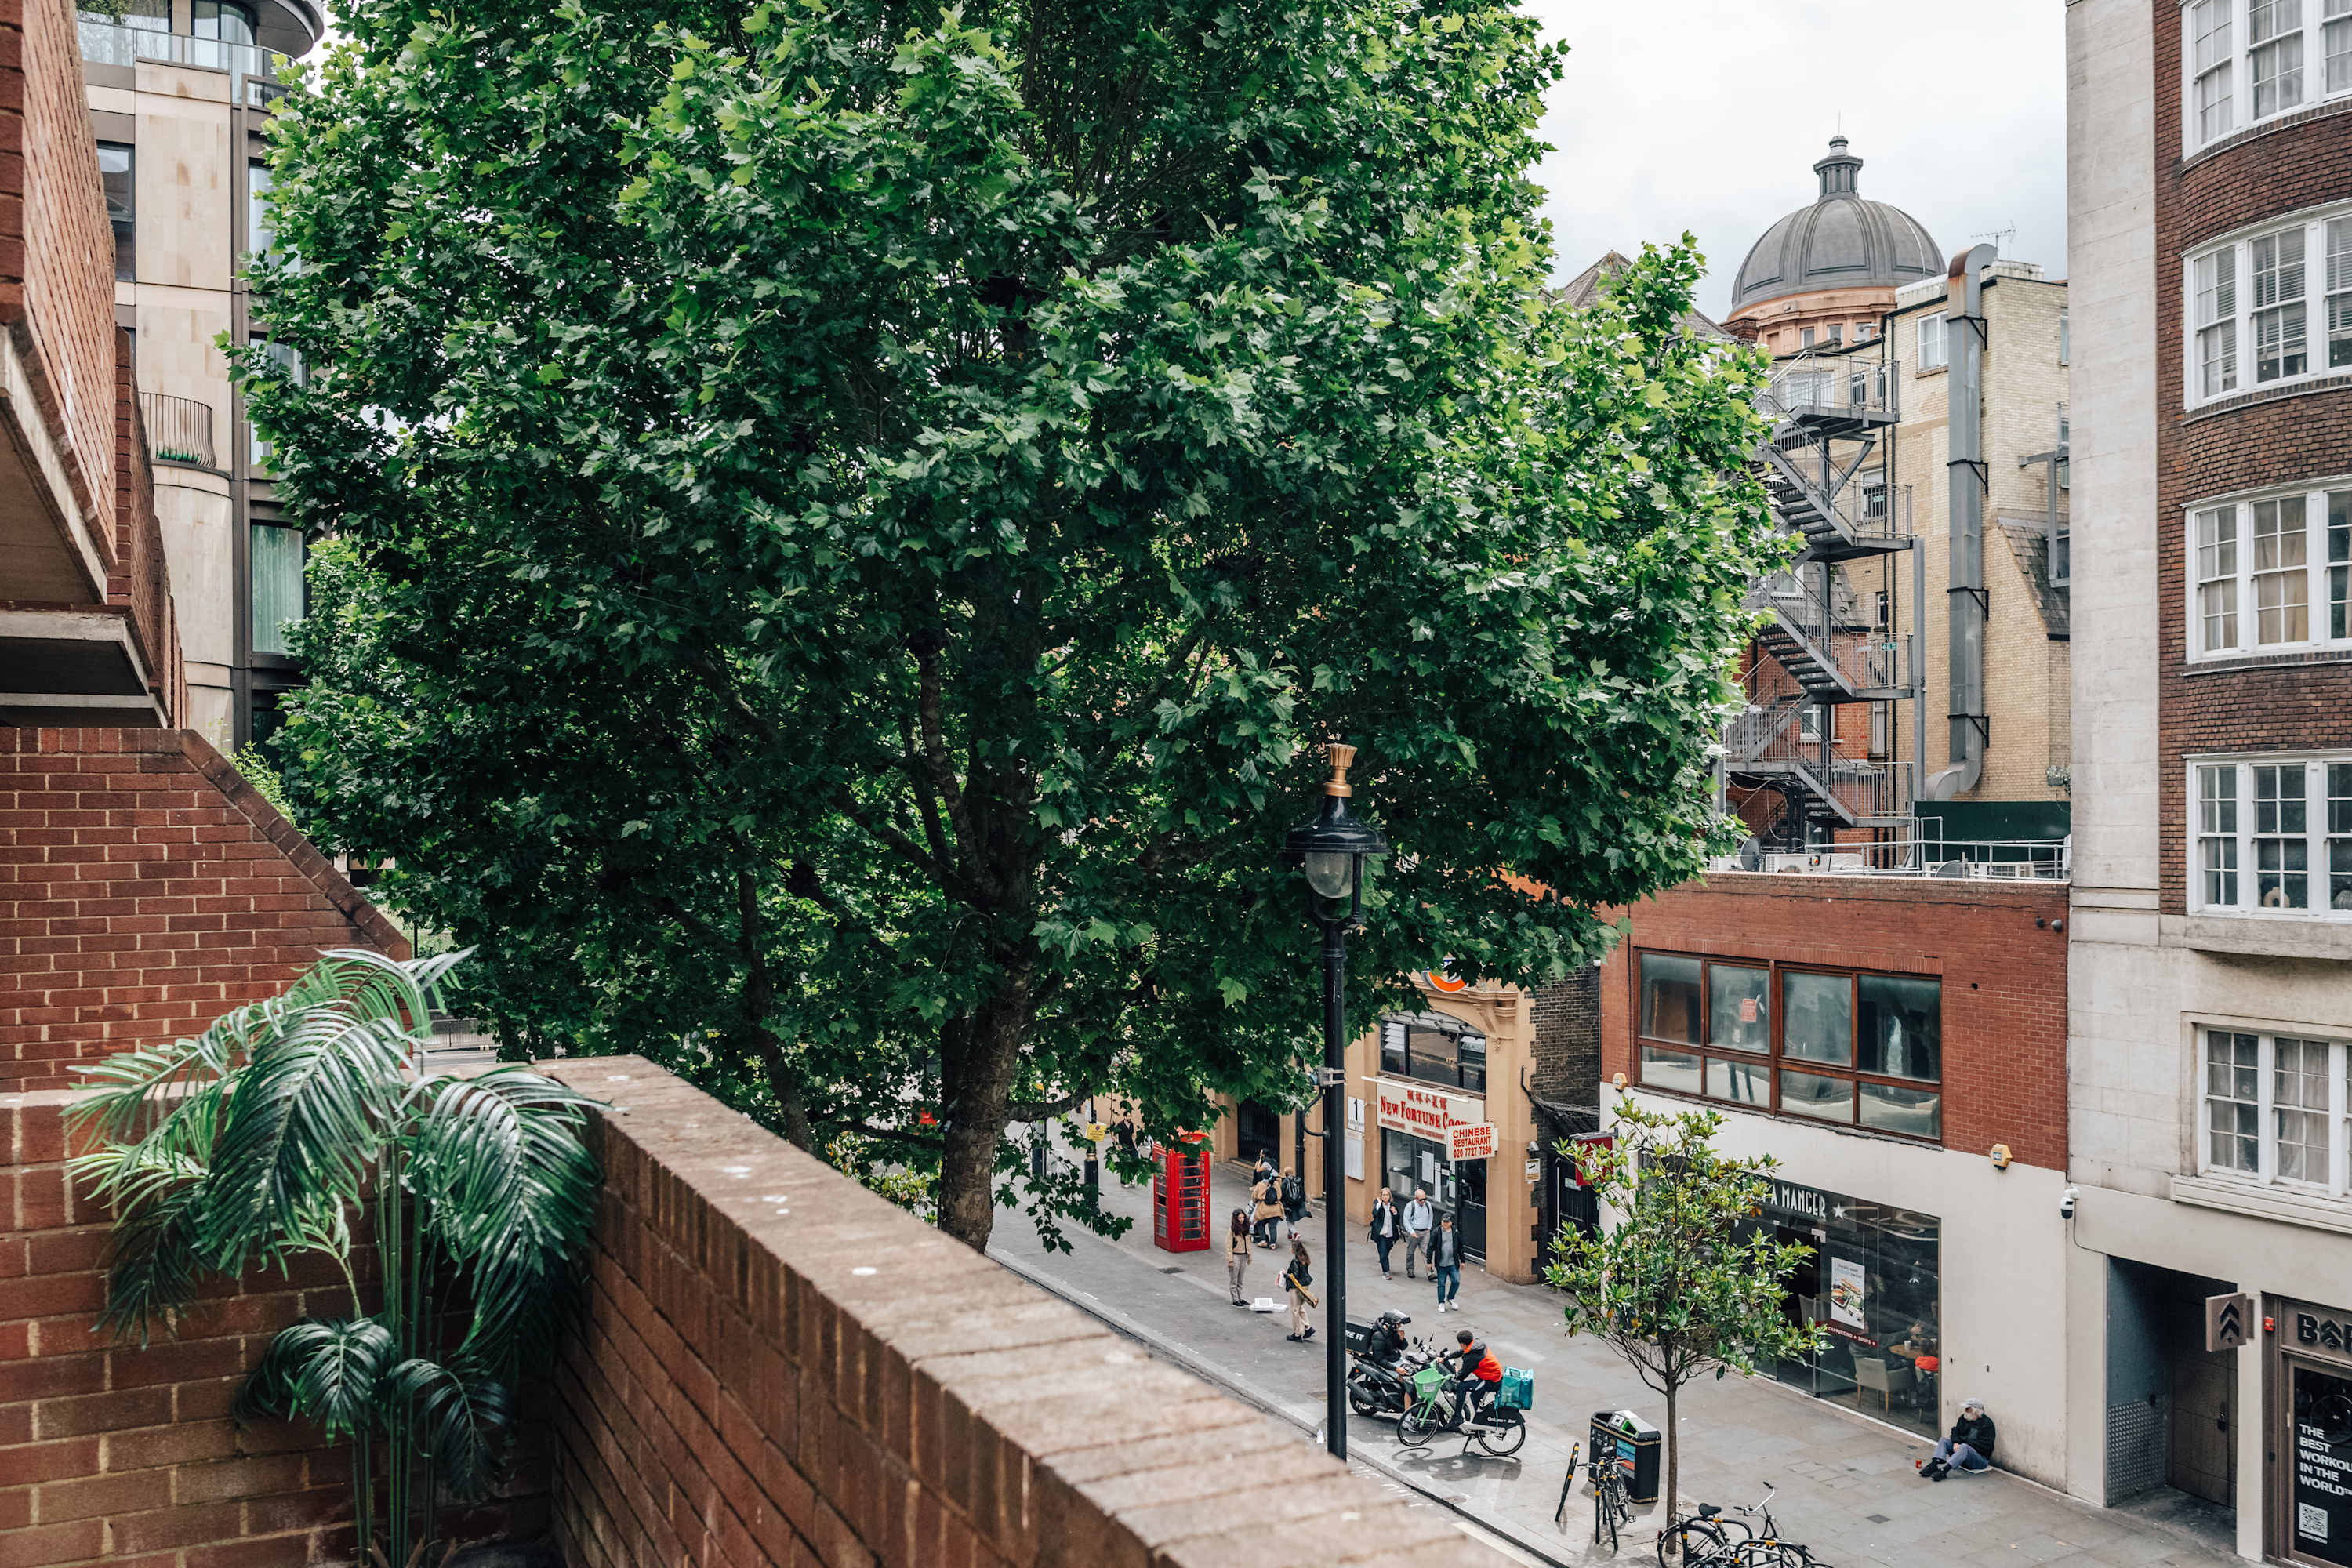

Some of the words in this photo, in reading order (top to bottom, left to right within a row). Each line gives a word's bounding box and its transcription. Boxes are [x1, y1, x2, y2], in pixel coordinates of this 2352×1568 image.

[1380, 1095, 1399, 1116] NEW
[1400, 1100, 1441, 1128] FORTUNE
[1453, 1127, 1491, 1138] CHINESE
[1453, 1136, 1491, 1148] RESTAURANT
[1454, 1148, 1463, 1159] 020
[1465, 1147, 1477, 1157] 7727
[1781, 1185, 1826, 1219] MANGER
[2299, 1423, 2325, 1439] THE
[2299, 1436, 2332, 1454] BEST
[2299, 1462, 2314, 1476] IN
[2315, 1466, 2339, 1482] THE
